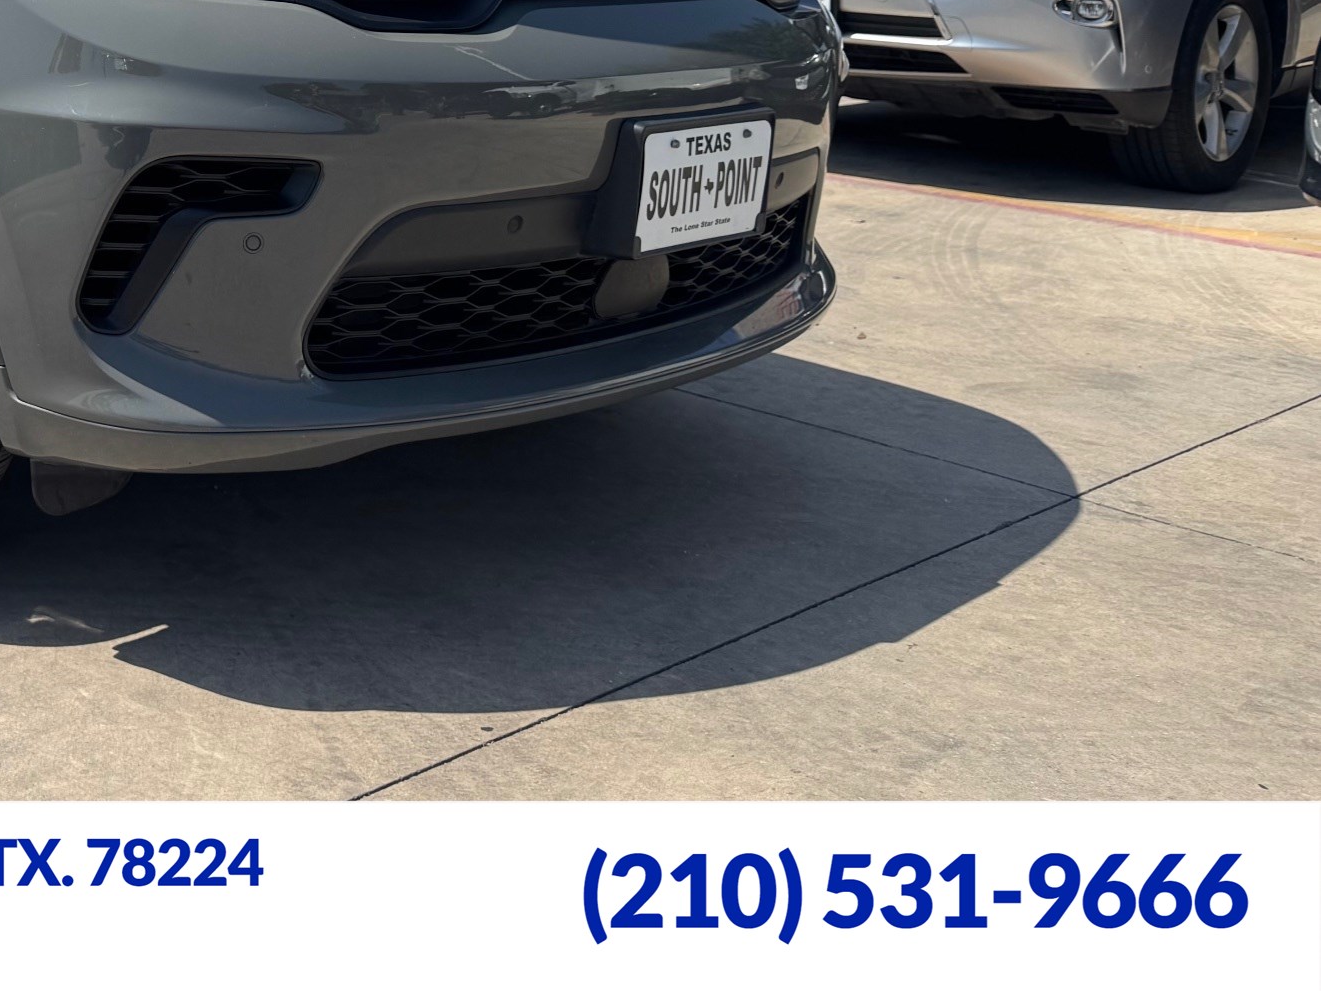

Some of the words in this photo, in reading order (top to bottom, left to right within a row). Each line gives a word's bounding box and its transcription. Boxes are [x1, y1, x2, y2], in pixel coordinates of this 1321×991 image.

[686, 132, 732, 156] TEXAS
[646, 164, 703, 221] SOUTH
[713, 156, 763, 208] POINT
[684, 223, 699, 231] Lone
[700, 220, 713, 228] Star
[714, 217, 731, 225] State
